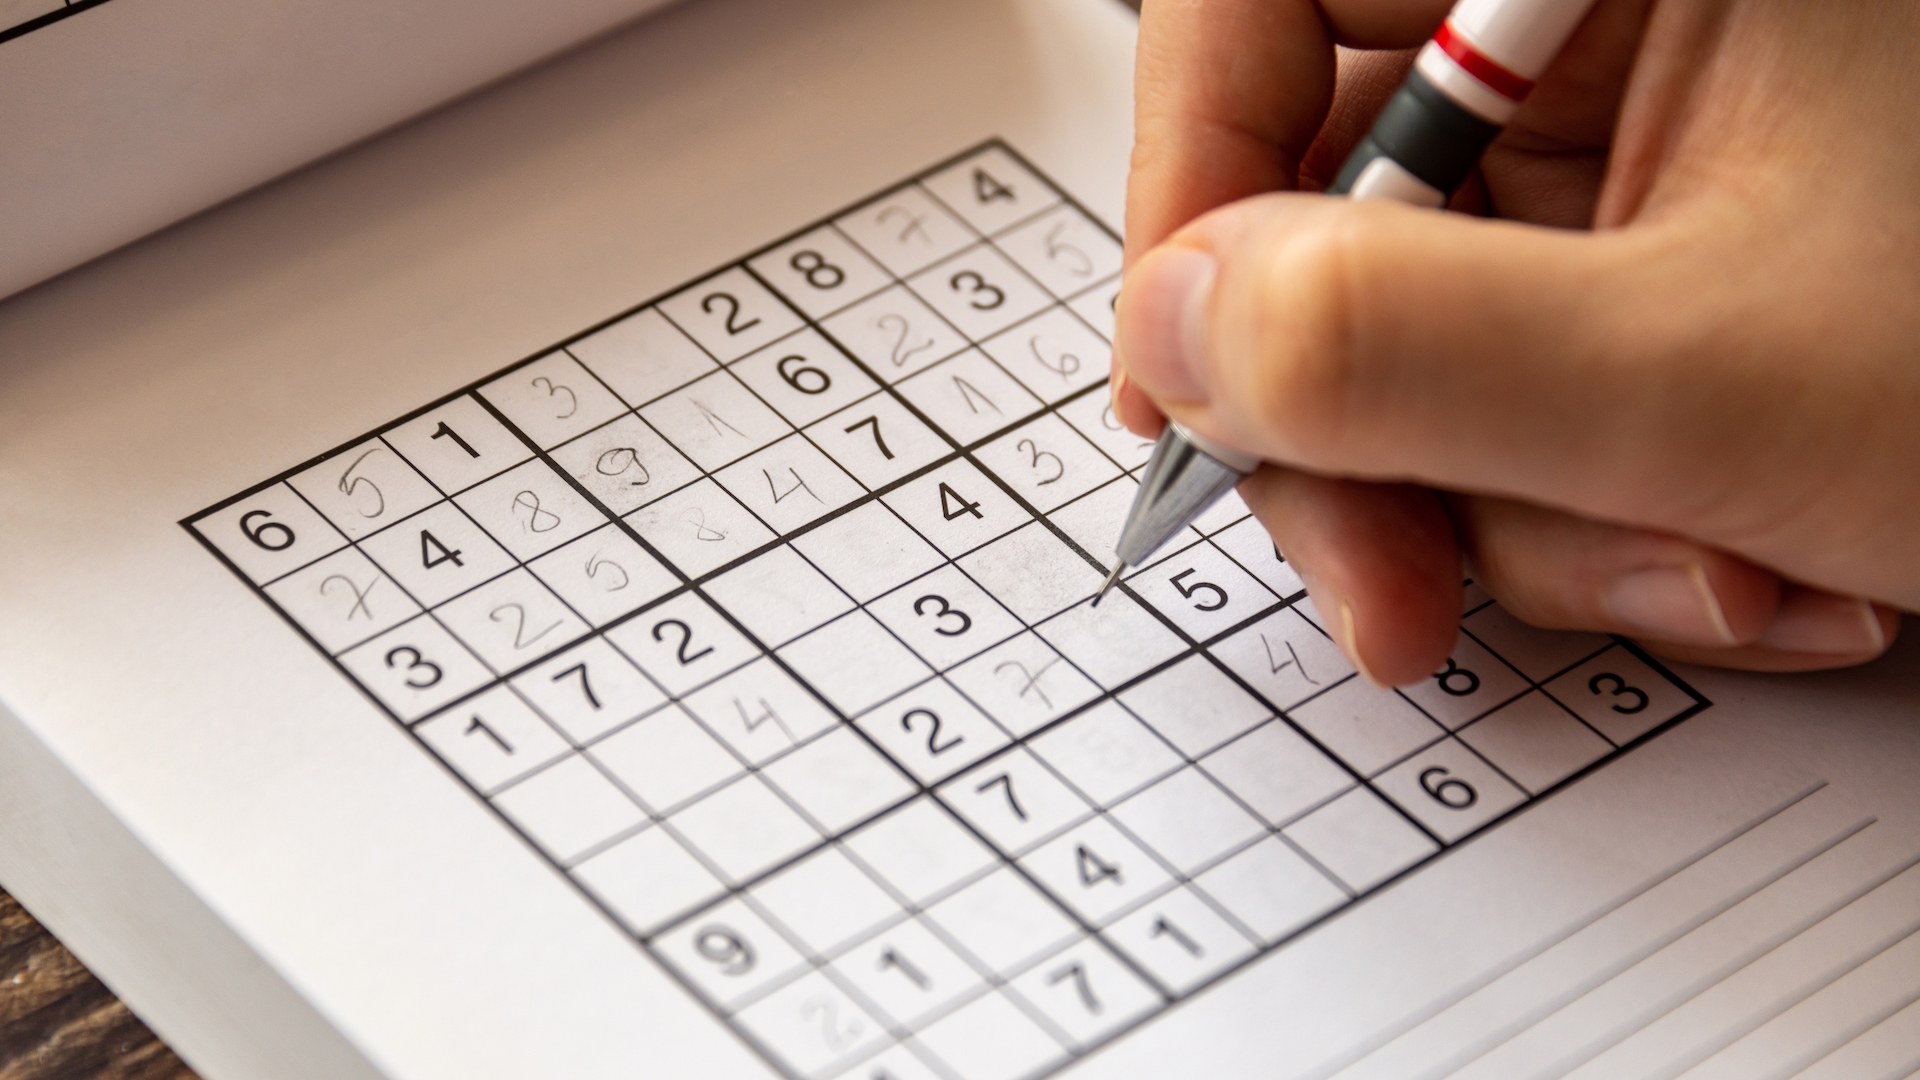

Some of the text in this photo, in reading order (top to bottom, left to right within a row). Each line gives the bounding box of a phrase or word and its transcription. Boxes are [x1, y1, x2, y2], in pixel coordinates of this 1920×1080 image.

[970, 166, 1018, 206] 4
[874, 205, 934, 248] 7
[789, 249, 845, 291] 8
[1042, 220, 1094, 279] 5
[949, 270, 1006, 311] 3
[700, 292, 761, 336] 2
[876, 313, 934, 368] 2
[1029, 334, 1080, 384] 6
[776, 355, 832, 395] 6
[951, 374, 1004, 417] 1
[532, 377, 577, 419] 3
[430, 421, 481, 459] 1
[843, 415, 895, 461] 7
[338, 448, 385, 519] 5
[596, 448, 649, 485] 9
[1017, 438, 1064, 487] 3
[762, 466, 827, 505] 4
[937, 481, 984, 521] 4
[239, 510, 296, 552] 6
[511, 490, 560, 533] 8
[420, 529, 464, 570] 4
[320, 574, 381, 621] 7
[1168, 568, 1229, 612] 5
[489, 602, 565, 649] 2
[913, 594, 972, 638] 3
[651, 618, 715, 665] 2
[1261, 633, 1320, 686] 4
[384, 645, 443, 690] 3
[551, 662, 602, 711] 7
[993, 656, 1063, 710] 7
[1588, 671, 1649, 714] 3
[463, 713, 515, 755] 1
[733, 697, 800, 746] 4
[901, 707, 964, 757] 2
[976, 774, 1027, 820] 7
[1419, 766, 1478, 811] 6
[1077, 842, 1123, 889] 4
[692, 922, 757, 977] 9
[1149, 914, 1206, 959] 1
[875, 943, 934, 991] 1
[1045, 965, 1103, 1013] 7
